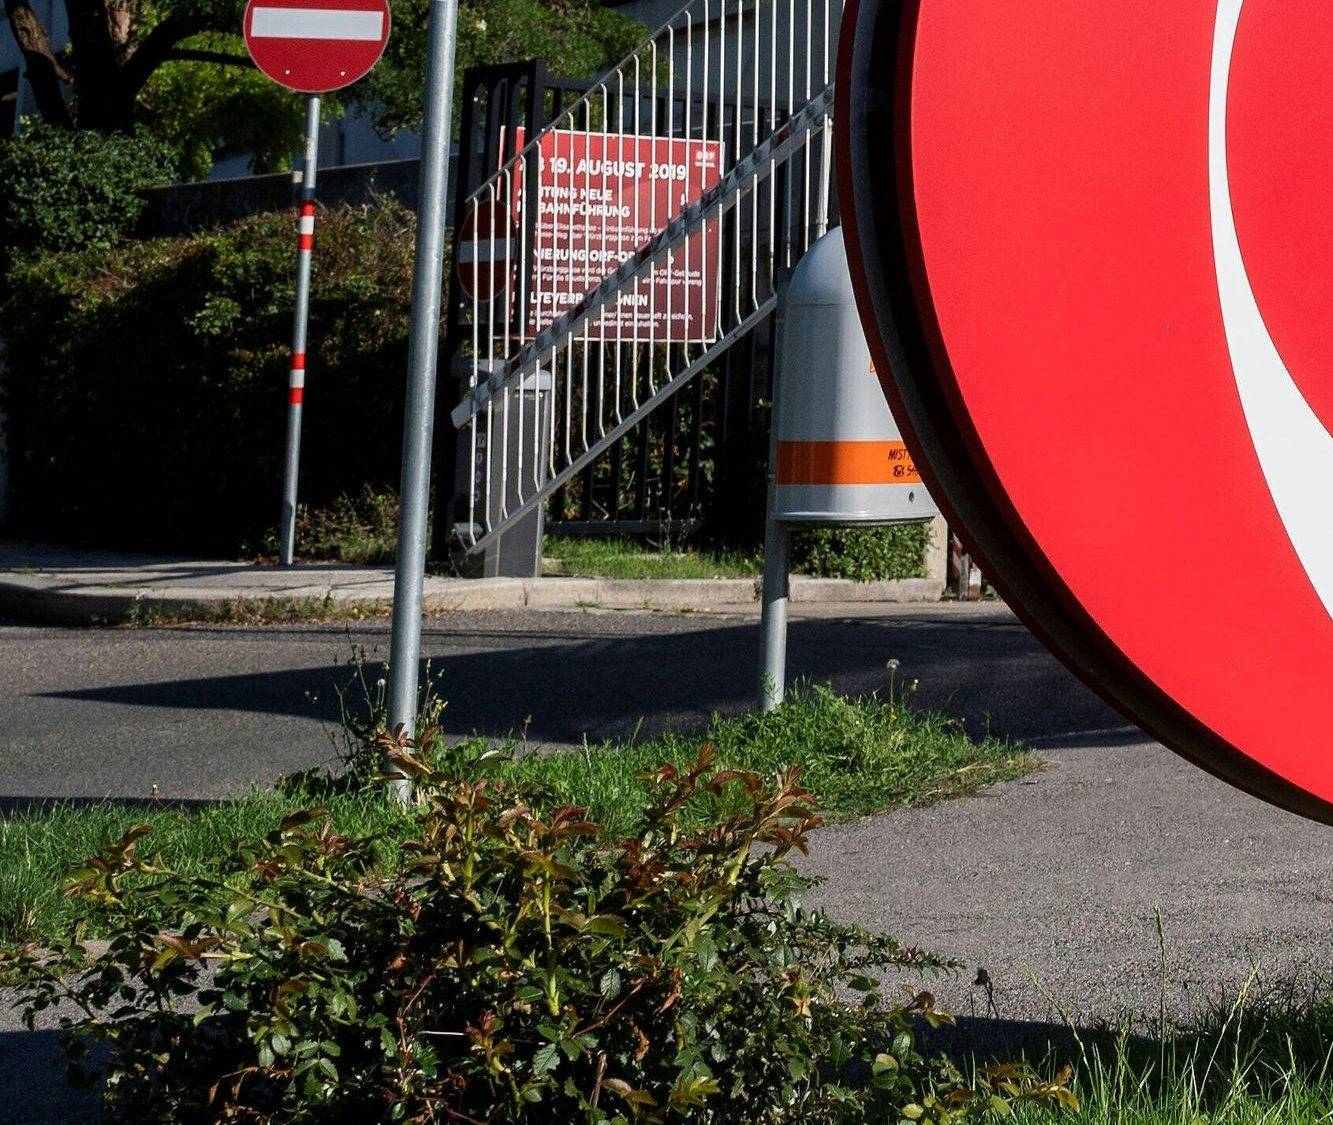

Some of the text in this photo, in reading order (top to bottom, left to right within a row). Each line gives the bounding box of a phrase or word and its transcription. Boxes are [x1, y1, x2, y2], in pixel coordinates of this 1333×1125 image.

[549, 156, 571, 174] 19.
[575, 158, 646, 178] AUGUST
[648, 162, 686, 181] 2019
[580, 187, 613, 202] NEUE
